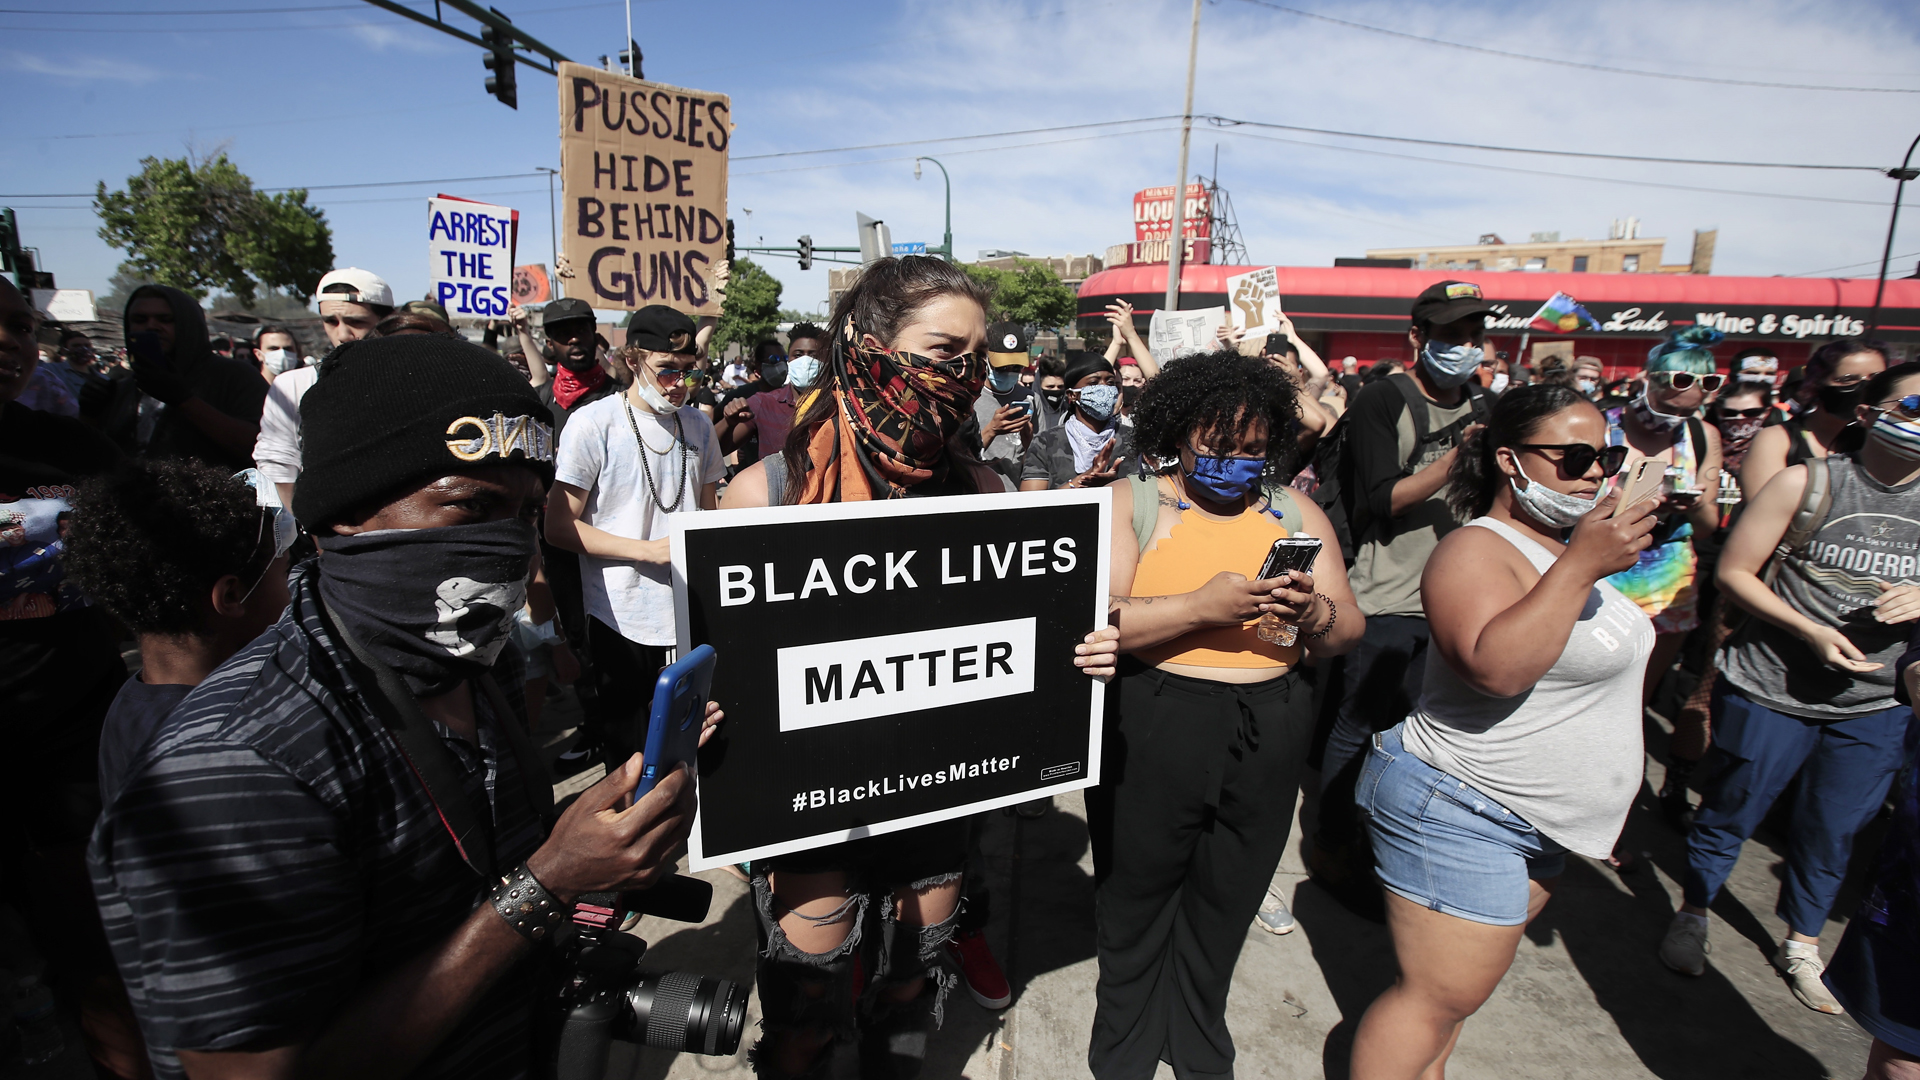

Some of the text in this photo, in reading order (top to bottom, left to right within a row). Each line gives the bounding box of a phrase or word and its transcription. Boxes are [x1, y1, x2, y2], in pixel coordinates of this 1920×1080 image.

[572, 77, 728, 151] PUSSIES
[594, 151, 693, 196] HIDE
[430, 211, 509, 249] ARREST
[577, 197, 723, 243] BEHIND
[1135, 198, 1208, 222] LIQURS
[440, 251, 493, 280] THE
[1132, 239, 1194, 264] LIQUOS
[588, 246, 709, 306] GUNS
[438, 282, 508, 316] PIGS
[1602, 307, 1669, 332] Lake
[1696, 311, 1755, 334] Wine
[1757, 314, 1779, 334] &
[1780, 314, 1864, 338] Spirits
[1845, 533, 1919, 550] NASHVILLE
[719, 537, 1077, 607] BLACK LIVES
[804, 641, 1014, 705] MATTER
[793, 755, 1020, 812] #BlackLivesMatter
